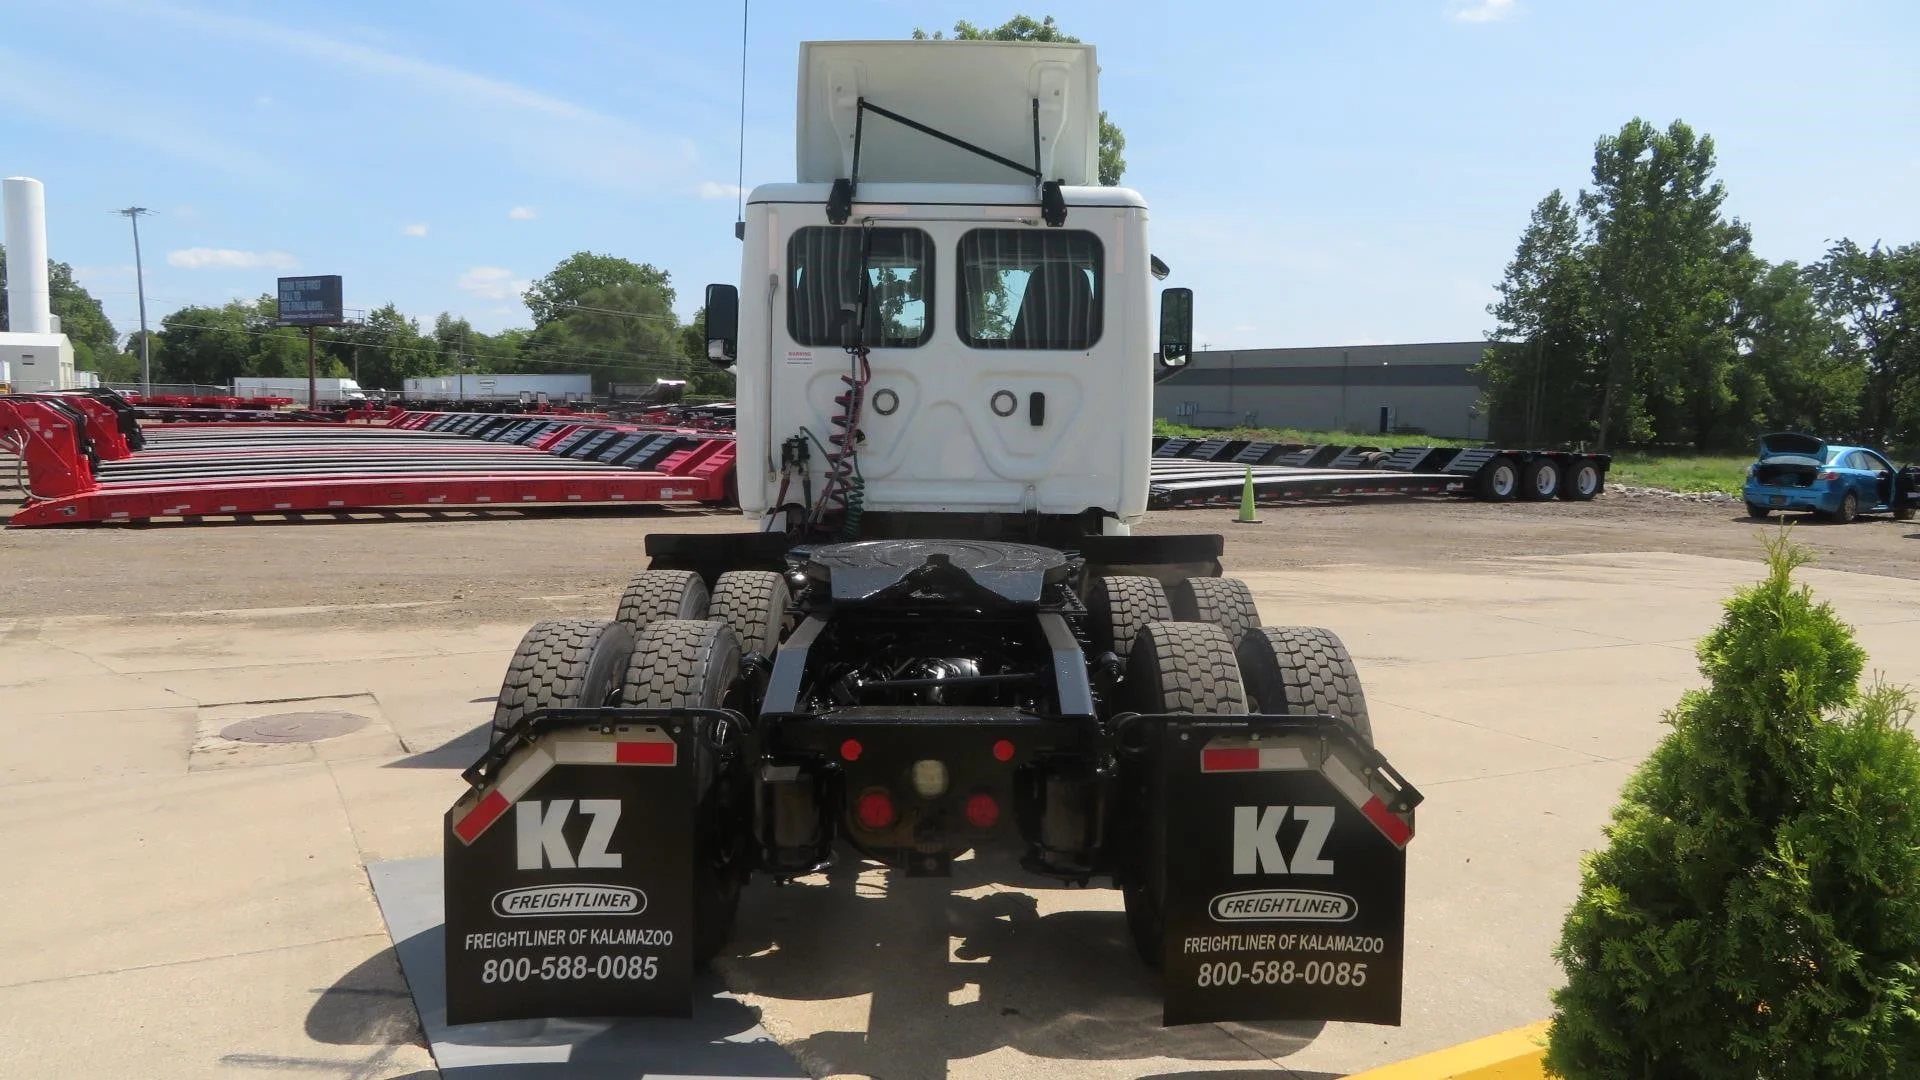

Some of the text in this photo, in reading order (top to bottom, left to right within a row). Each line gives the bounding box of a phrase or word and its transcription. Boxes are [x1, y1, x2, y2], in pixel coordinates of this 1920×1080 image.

[516, 799, 622, 870] KZ
[1234, 806, 1335, 874] KZ
[510, 893, 631, 909] FREIGHTLINER
[1224, 898, 1341, 913] FREIGHTLINER
[466, 929, 672, 949] FREIGHTLINER OF KALAMAZOO
[1185, 935, 1383, 953] FREIGHTLINER OF KALAMAZOO
[483, 956, 658, 983] 800-588-0085
[1198, 961, 1367, 986] 800-588-0085
